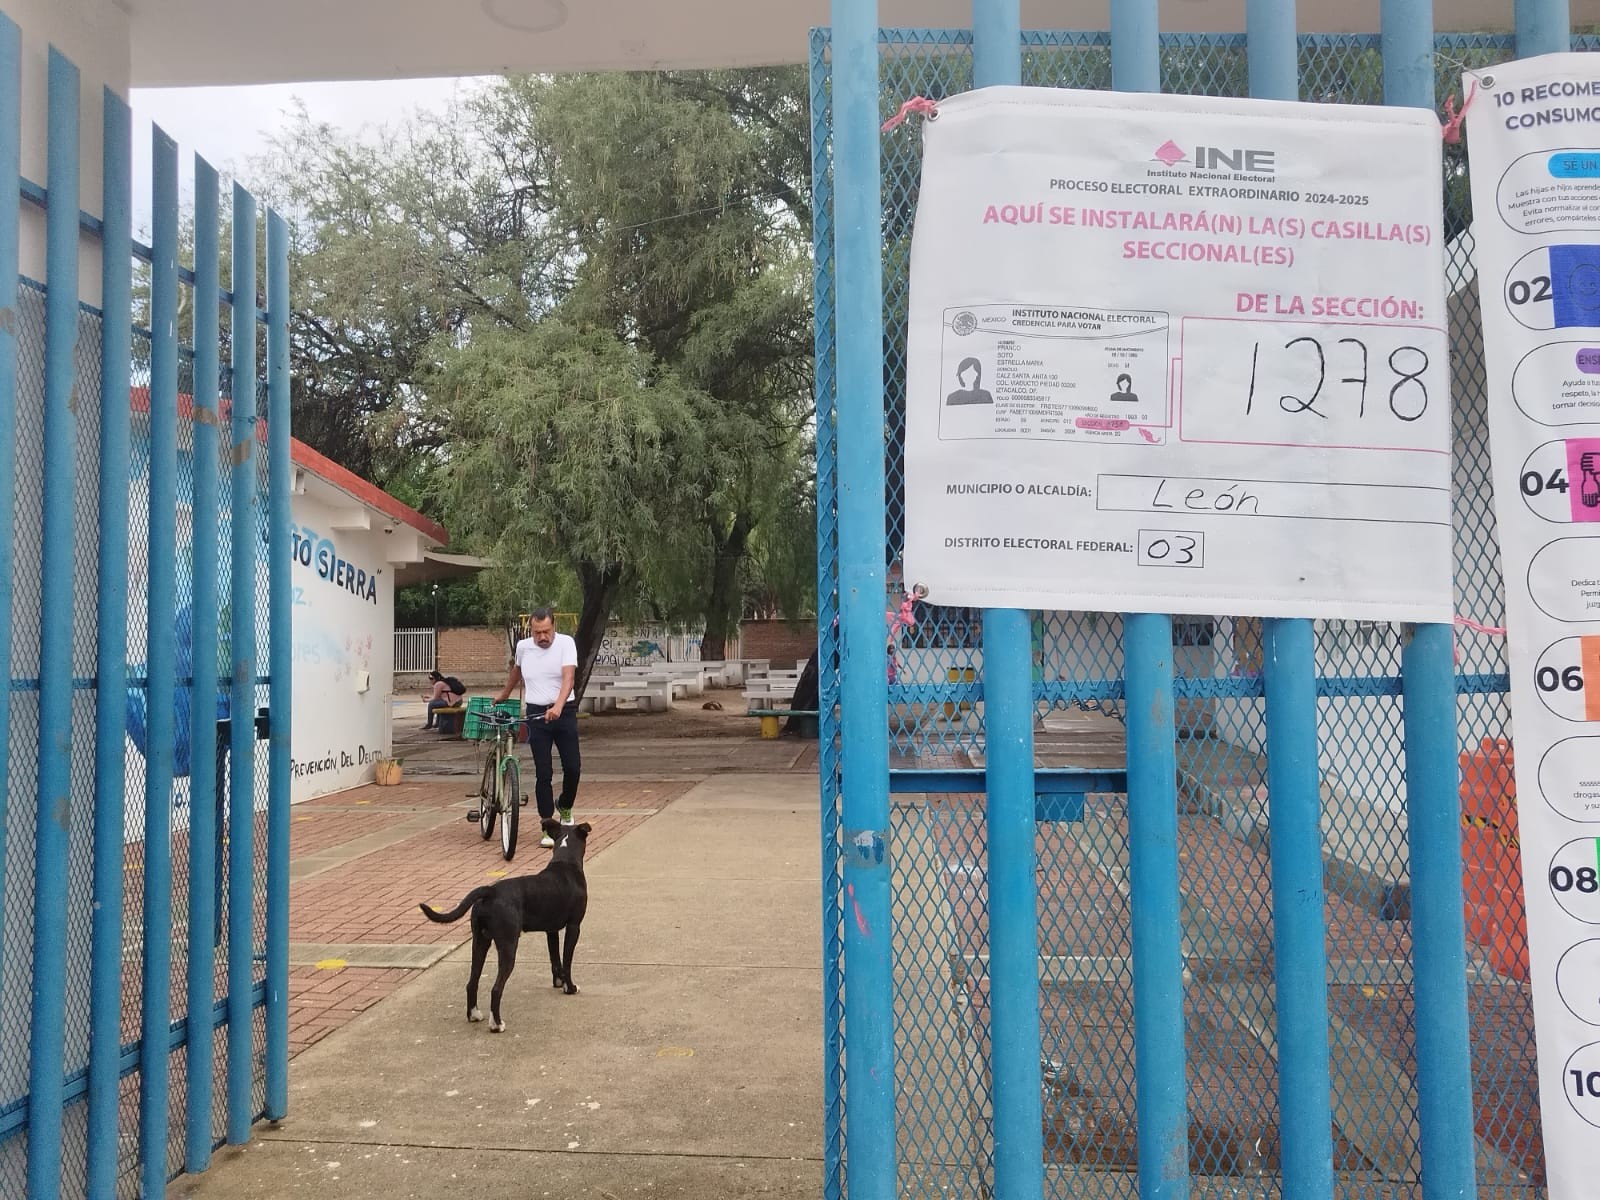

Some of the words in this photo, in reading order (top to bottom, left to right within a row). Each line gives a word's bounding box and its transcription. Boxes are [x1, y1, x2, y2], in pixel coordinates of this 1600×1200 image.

[1494, 91, 1515, 108] 10
[1195, 146, 1275, 173] INE
[1147, 169, 1187, 178] Instituto
[1190, 171, 1231, 181] Nacional
[1233, 173, 1275, 183] Electoral
[1050, 179, 1108, 192] PROCESO
[1111, 184, 1183, 196] ELECTORAL
[1188, 186, 1300, 202] EXTRAORDINARIO
[1305, 192, 1369, 206] 2024-2025
[1508, 197, 1540, 209] Muestra
[983, 203, 1044, 226] AQUÍ
[1048, 206, 1075, 226] SE
[1081, 208, 1242, 236] INSTALARÁ(N)
[1249, 216, 1306, 239] LA(S)
[1311, 220, 1431, 246] CASILLA(S)
[1523, 208, 1543, 217] Evita
[1122, 241, 1295, 268] SECCIONAL(ES)
[1508, 275, 1553, 305] 02
[1012, 309, 1059, 319] INSTITUTO
[1060, 311, 1105, 322] NACIONAL
[1106, 314, 1157, 324] ELECTORAL
[1236, 292, 1269, 314] DE
[1275, 294, 1305, 315] LA
[1311, 295, 1424, 320] SECCIÓN:
[1011, 319, 1056, 328] CREDENCIAL
[1057, 321, 1077, 329] PARA
[1078, 322, 1102, 330] VOTAR
[1247, 337, 1429, 421] 1278
[1562, 379, 1586, 388] Ayuda
[946, 483, 1012, 496] MUNICIPIO
[1014, 485, 1026, 497] O
[1028, 484, 1092, 497] ALCALDÍA:
[1152, 479, 1259, 513] León
[1521, 468, 1569, 497] 04
[944, 537, 1001, 549] DISTRITO
[1003, 538, 1074, 551] ELECTORAL
[1076, 540, 1134, 553] FEDERAL:
[1147, 535, 1196, 564] 03
[1537, 666, 1584, 692] 06
[1550, 866, 1598, 893] 08
